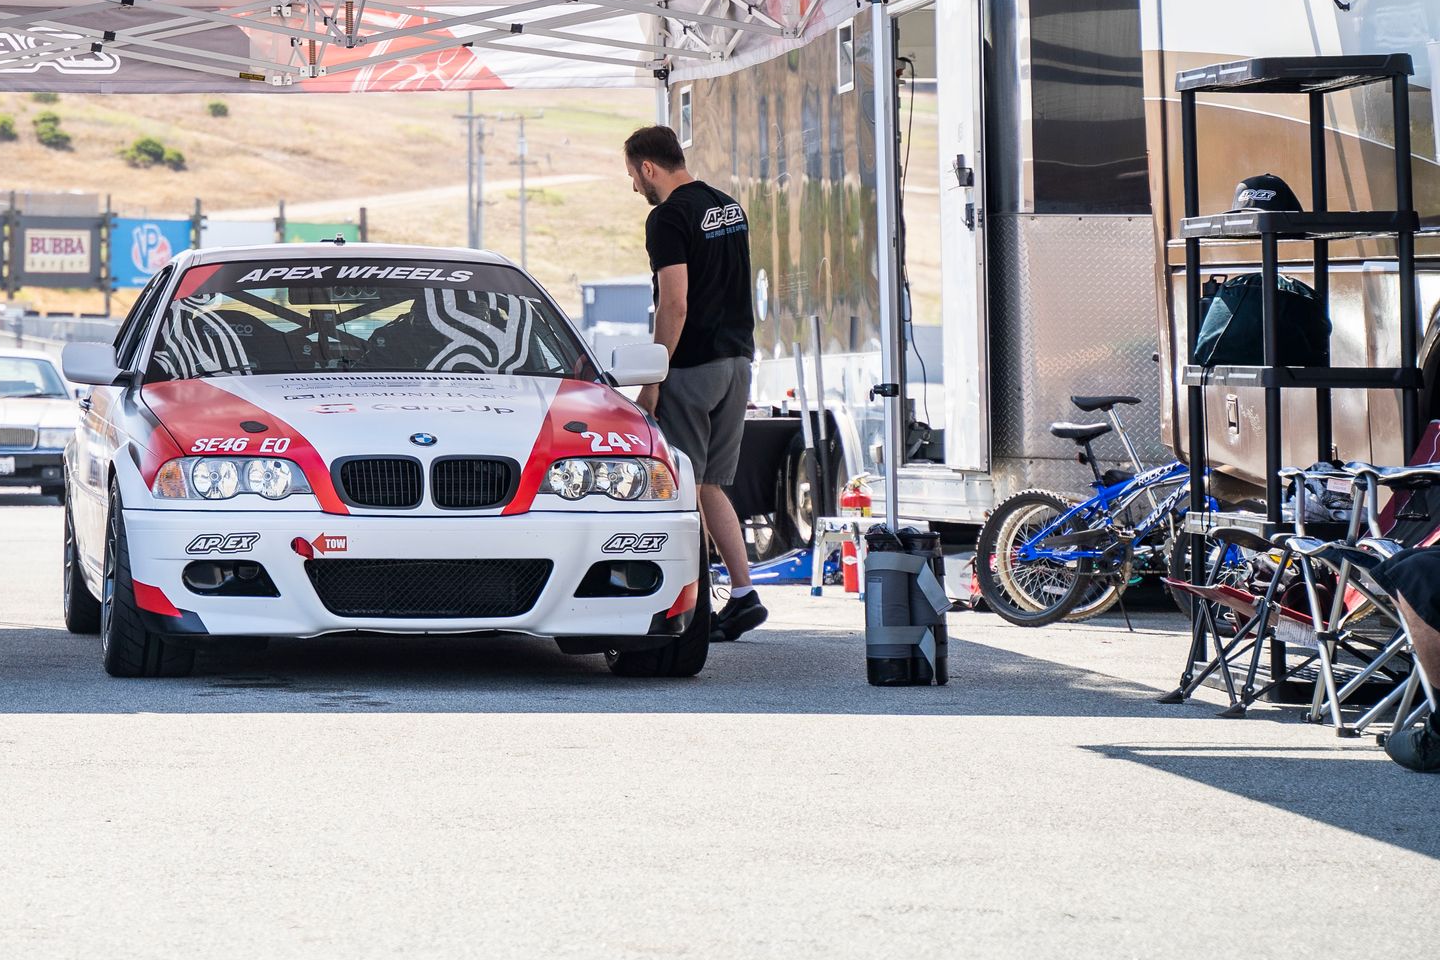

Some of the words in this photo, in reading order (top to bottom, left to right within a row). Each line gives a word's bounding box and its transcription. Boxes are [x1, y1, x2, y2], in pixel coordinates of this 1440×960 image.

[704, 206, 742, 228] APEX
[30, 237, 84, 255] BUBBA
[236, 266, 332, 283] APEX
[337, 266, 474, 283] WHEELS
[191, 438, 250, 452] SE46
[189, 535, 256, 551] APEX
[325, 538, 346, 549] TOW
[604, 535, 665, 551] APEX
